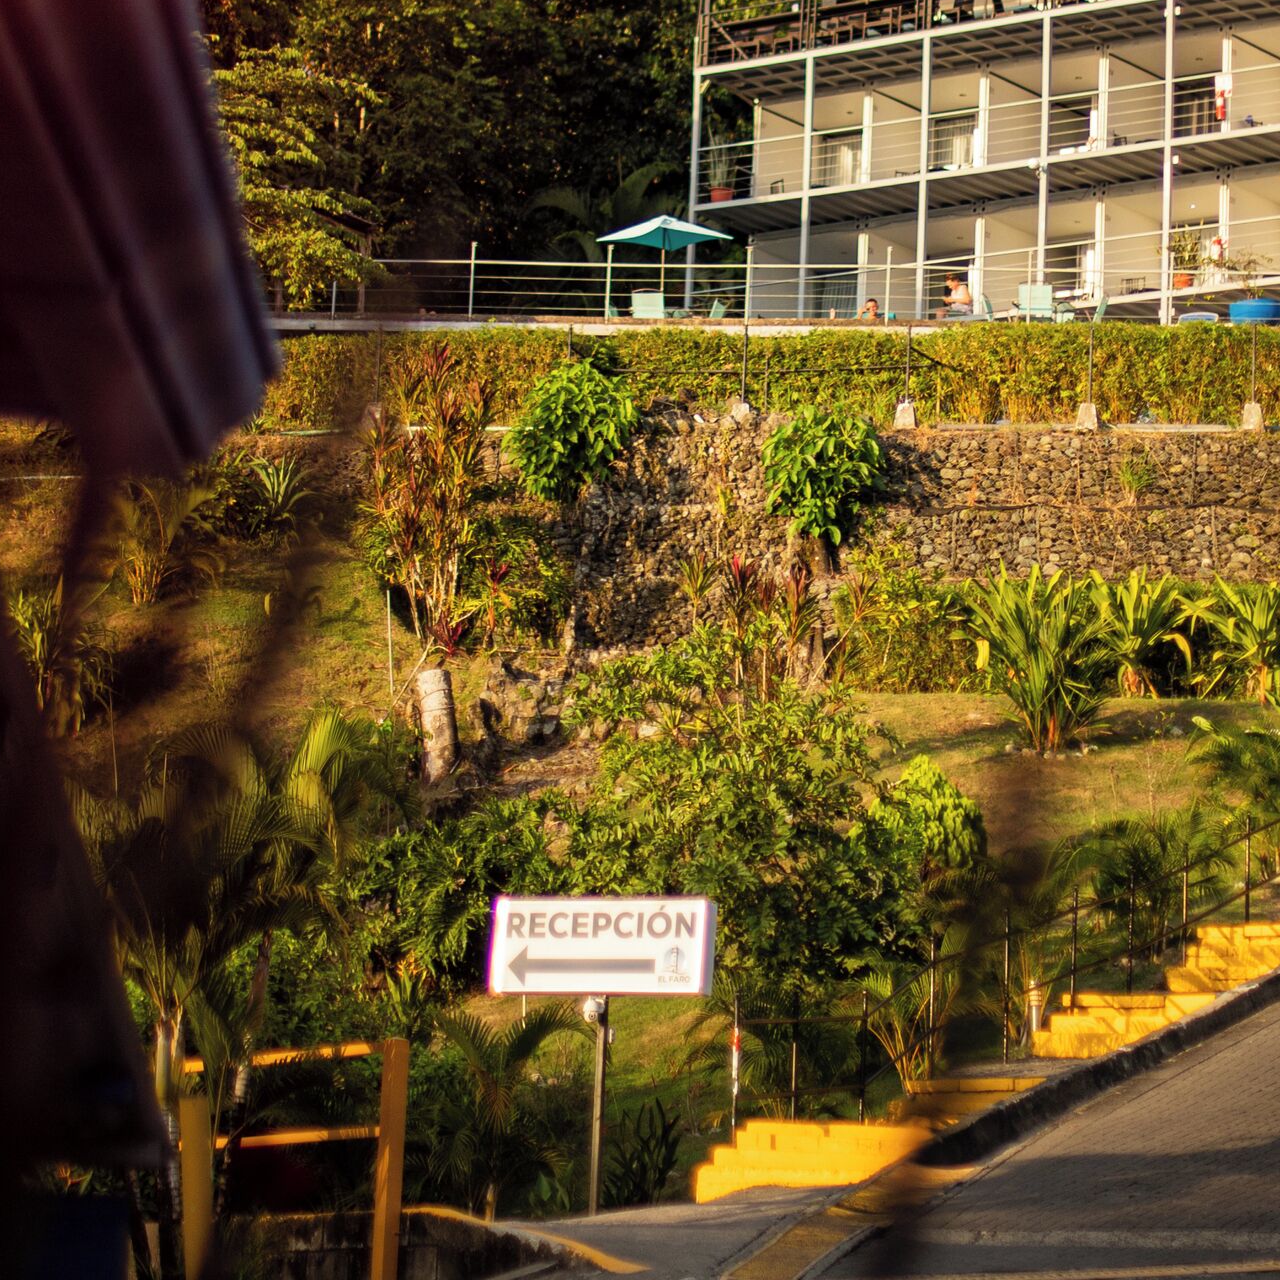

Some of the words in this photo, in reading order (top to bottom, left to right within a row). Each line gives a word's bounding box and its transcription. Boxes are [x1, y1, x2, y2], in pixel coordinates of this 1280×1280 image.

[506, 905, 697, 939] RECEPCIÓN
[657, 975, 667, 984] EL
[669, 975, 691, 984] FARO
